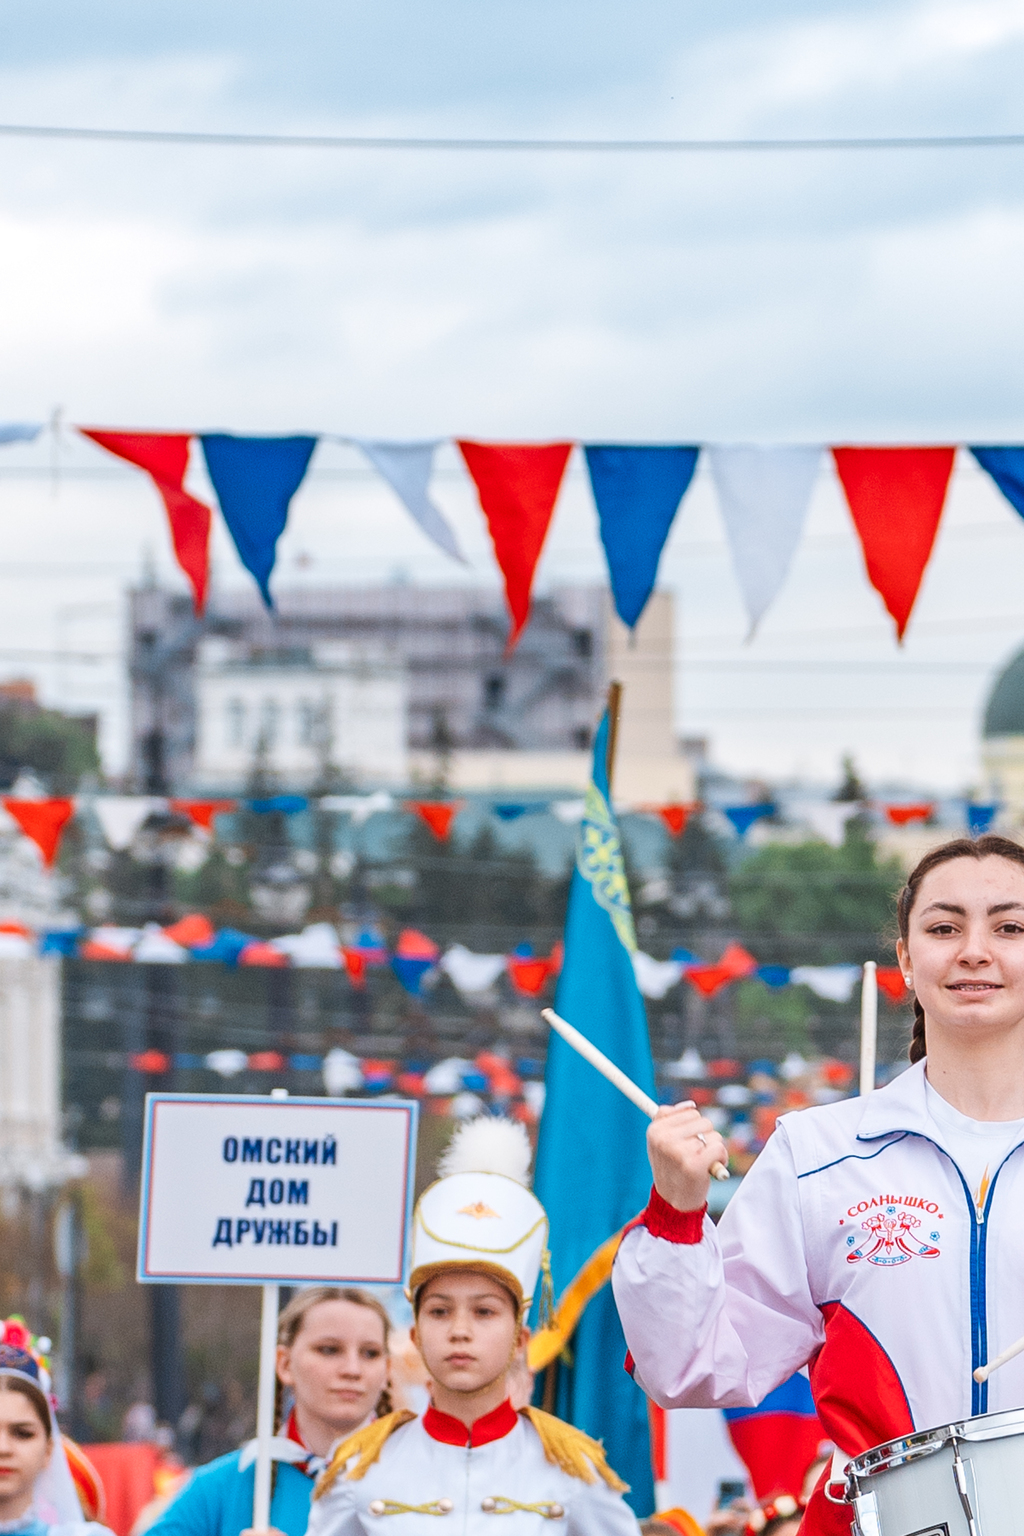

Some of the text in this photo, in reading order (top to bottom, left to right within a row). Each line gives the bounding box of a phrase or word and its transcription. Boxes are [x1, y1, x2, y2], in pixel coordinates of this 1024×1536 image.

[223, 1133, 337, 1165] ОМСКИЙ
[245, 1178, 309, 1208] ДОМ
[847, 1194, 939, 1217] СОЛНЫШКО
[212, 1218, 338, 1248] ДРУЖБЫ
